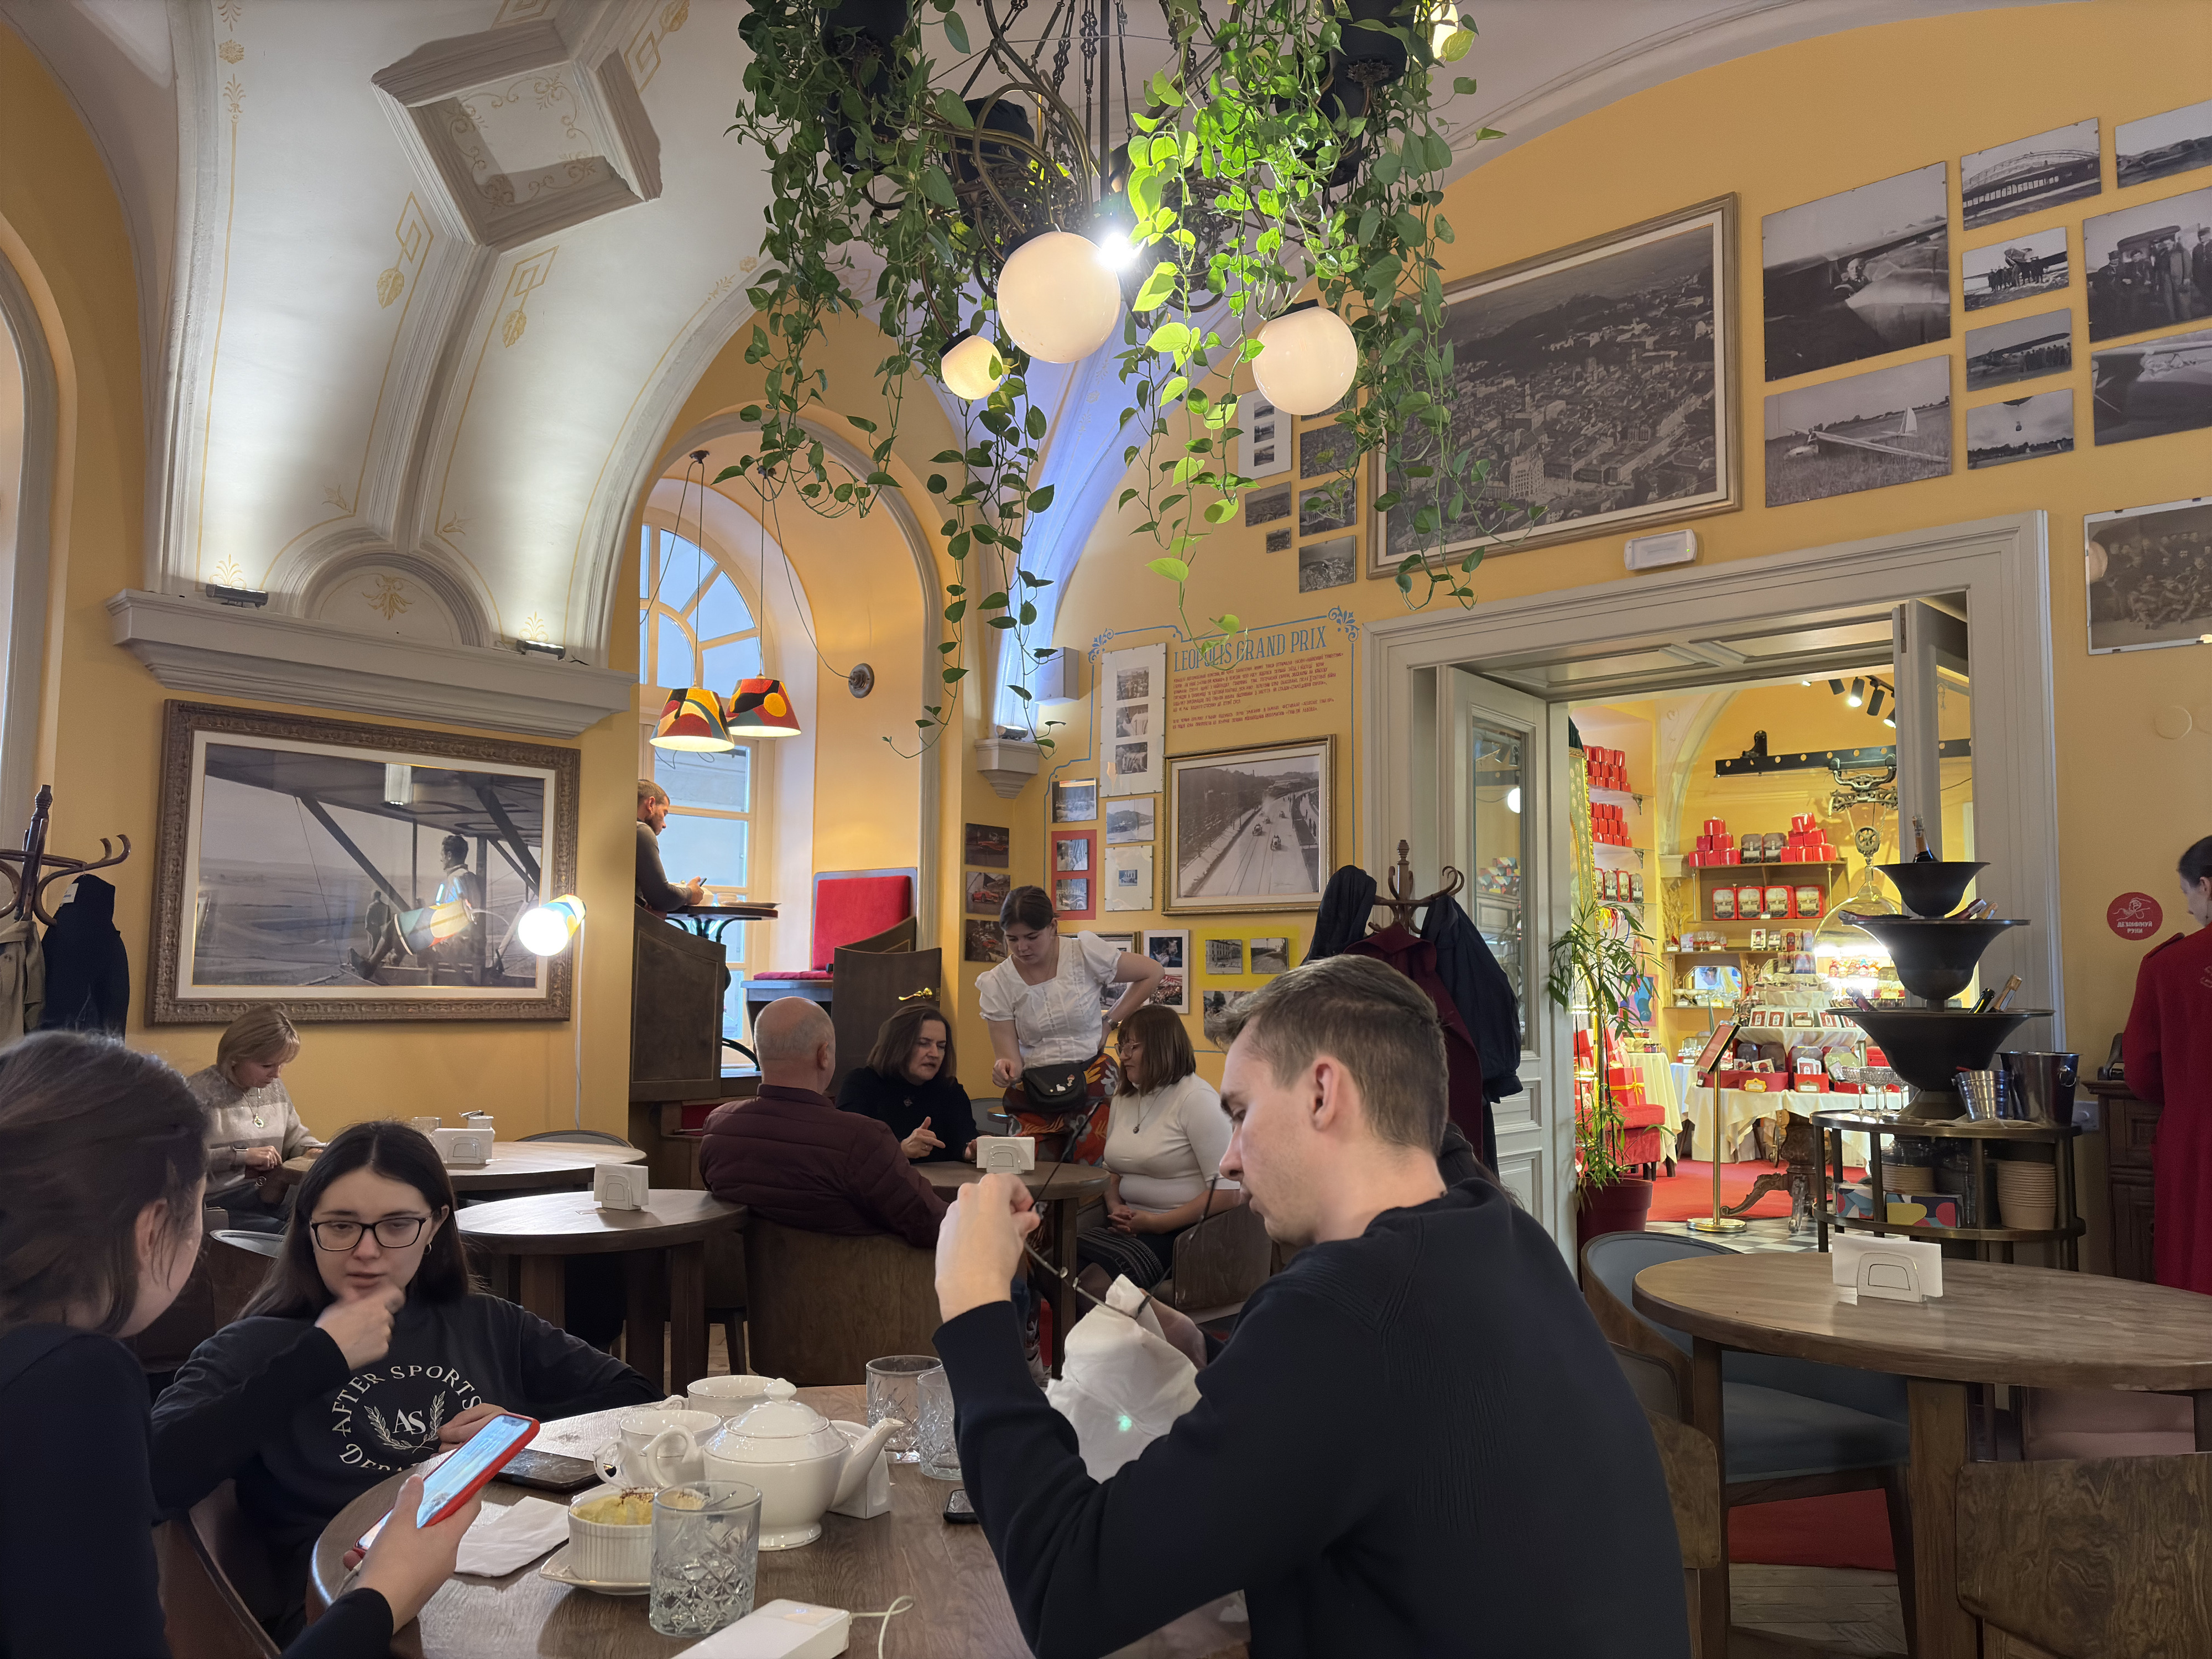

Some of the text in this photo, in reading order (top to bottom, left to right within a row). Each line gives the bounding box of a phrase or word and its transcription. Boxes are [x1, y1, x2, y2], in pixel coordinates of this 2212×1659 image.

[1174, 626, 1327, 672] LEOPOLIS GRAND PRIX
[332, 1365, 482, 1438] AFTER SPORTS
[392, 1408, 427, 1434] AS
